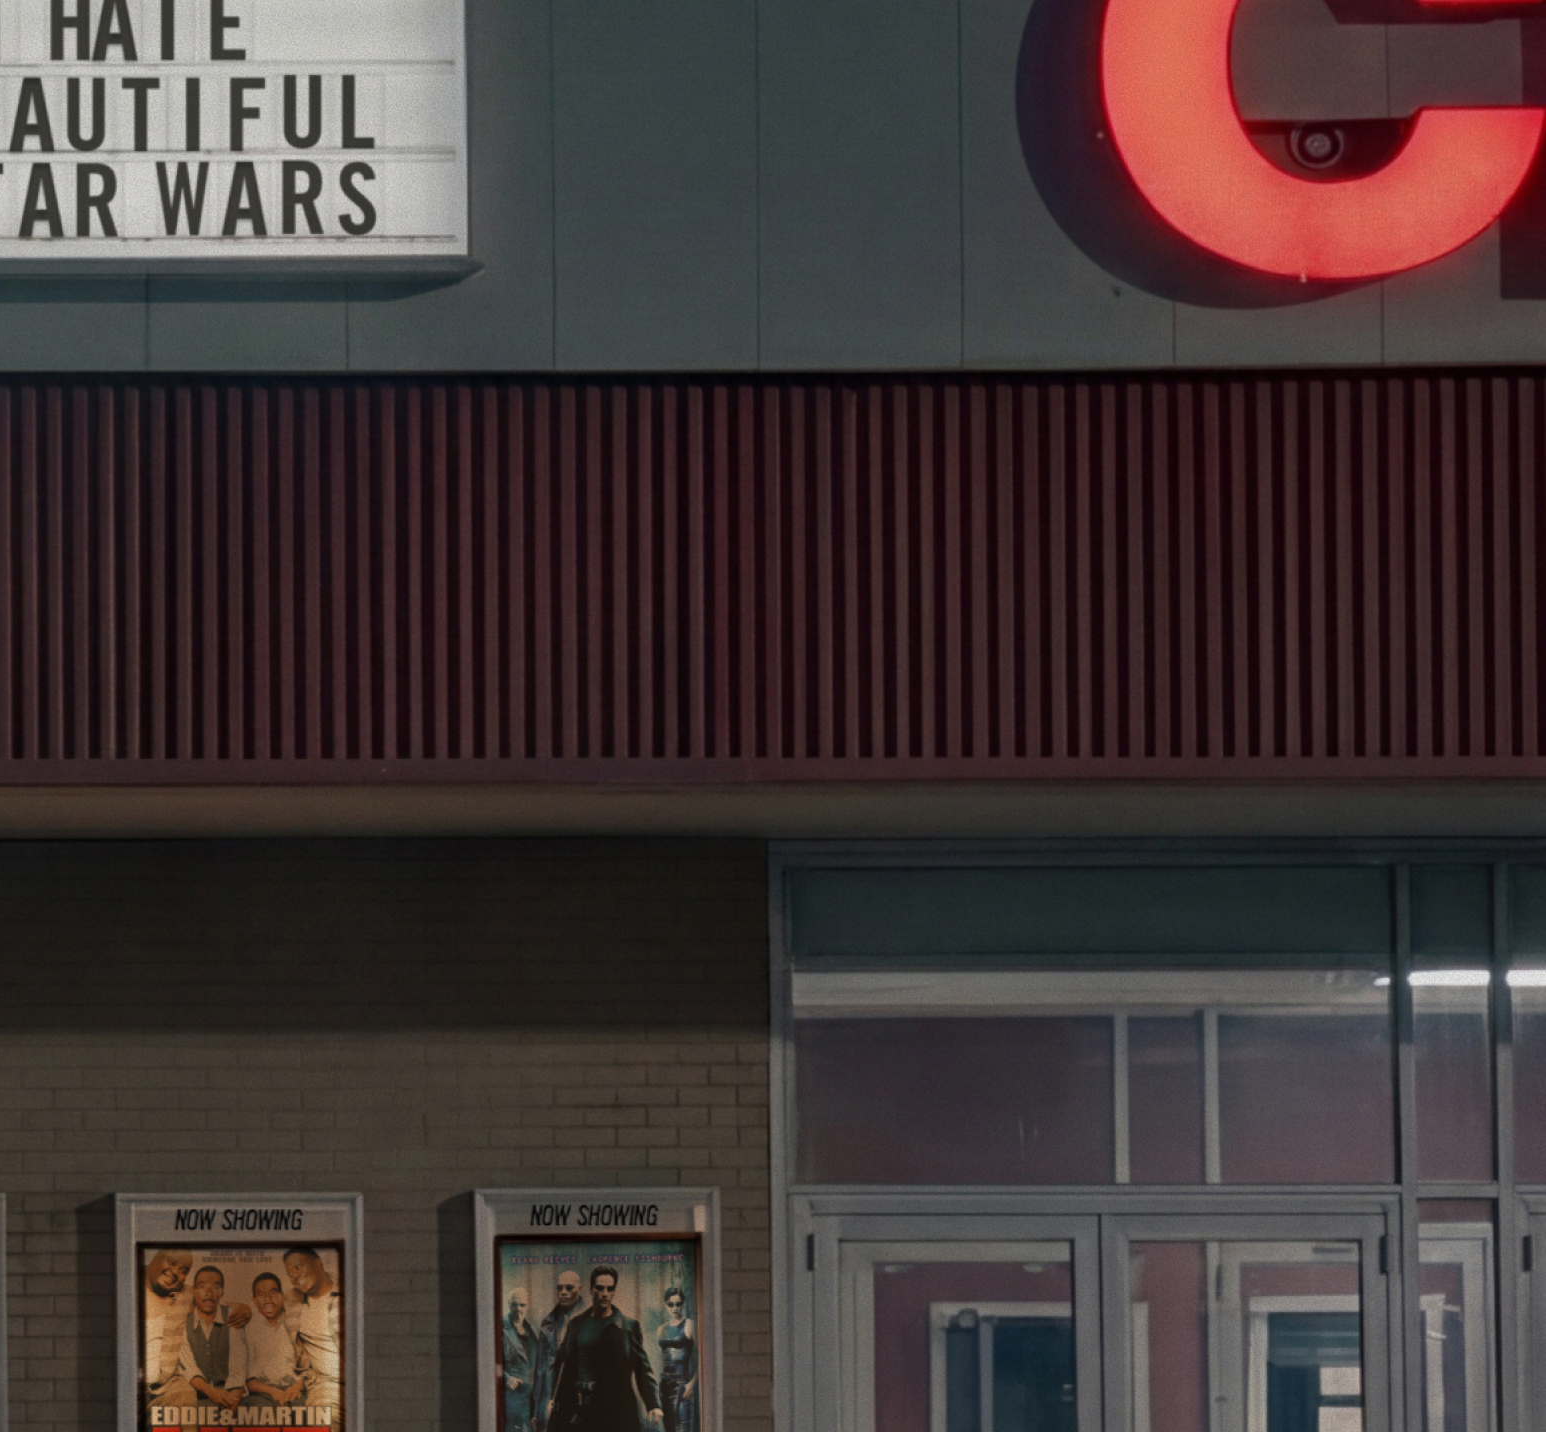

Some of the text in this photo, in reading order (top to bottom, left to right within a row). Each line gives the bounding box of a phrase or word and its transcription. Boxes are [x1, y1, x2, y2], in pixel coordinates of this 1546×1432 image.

[49, 0, 248, 62] HATE
[156, 162, 378, 236] WARS
[175, 1209, 303, 1231] NOW SHOWING
[530, 1204, 658, 1226] NOW SHOWING
